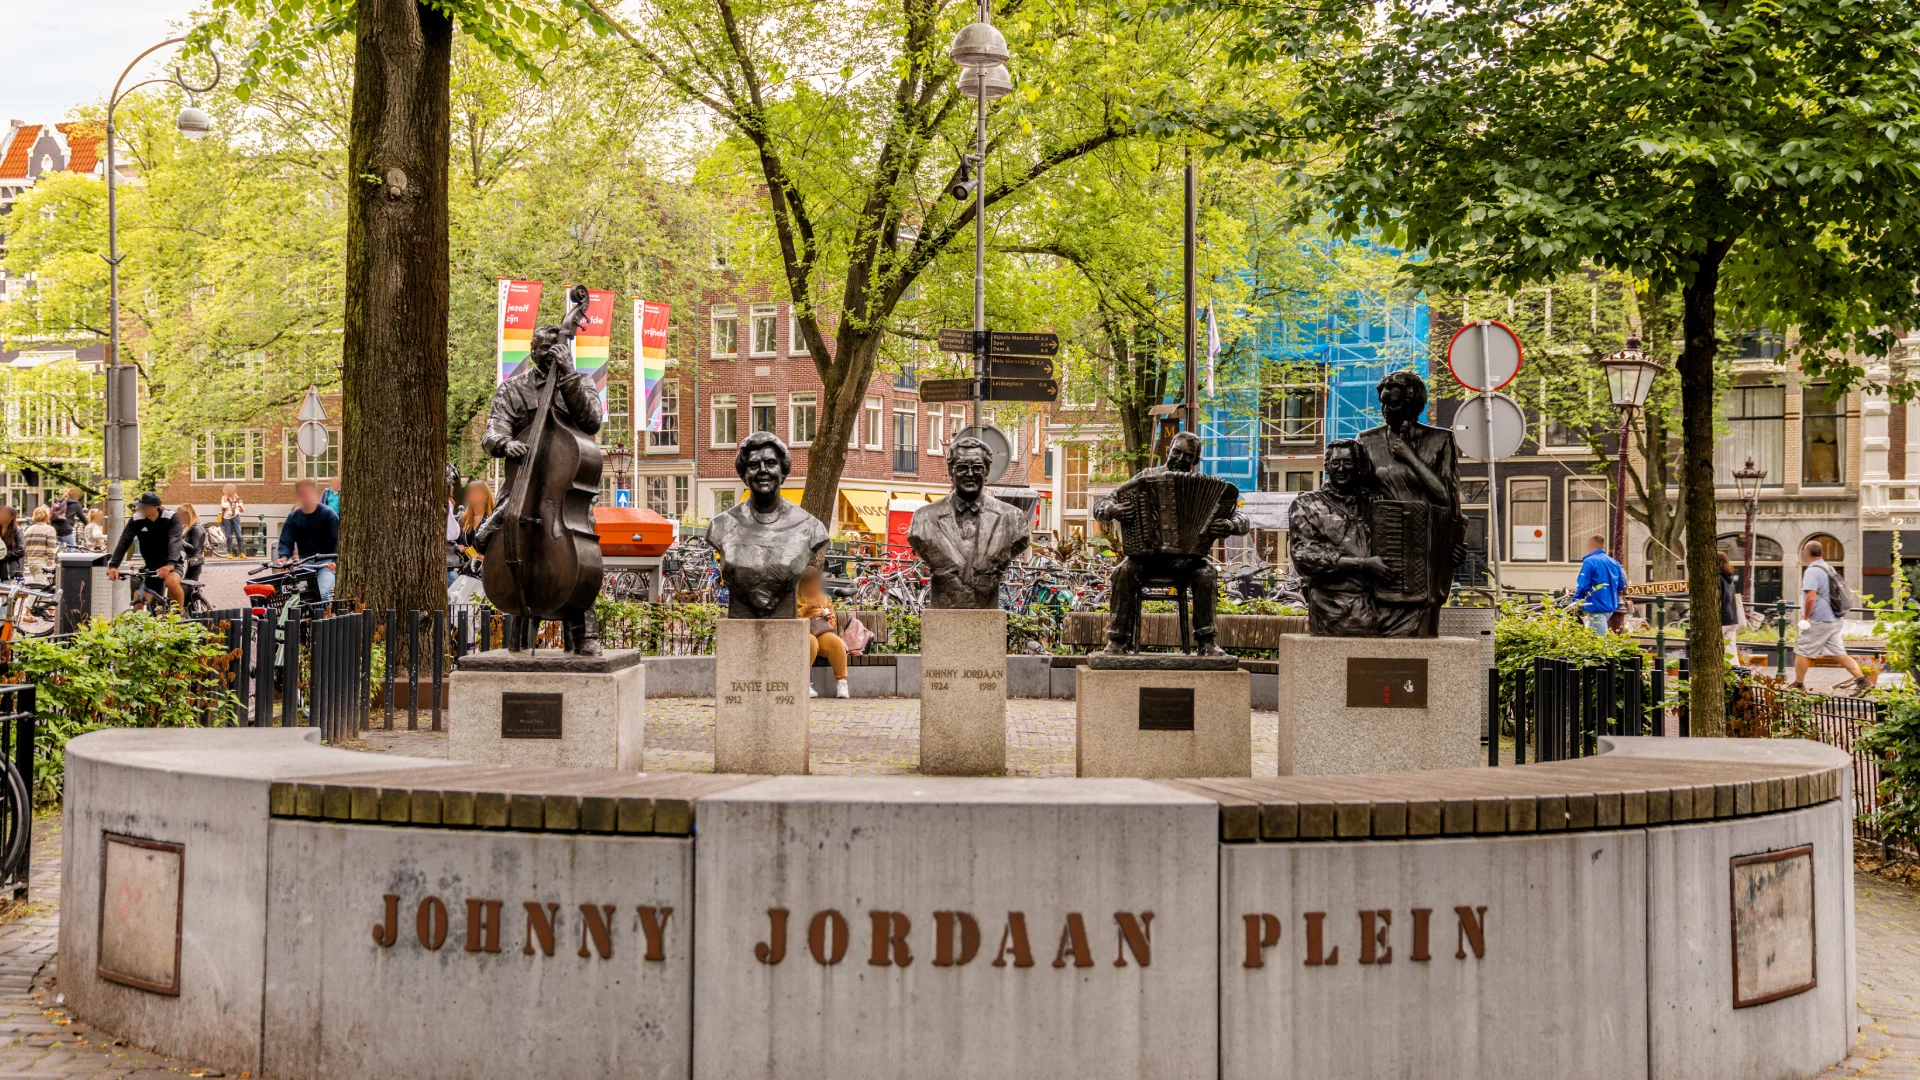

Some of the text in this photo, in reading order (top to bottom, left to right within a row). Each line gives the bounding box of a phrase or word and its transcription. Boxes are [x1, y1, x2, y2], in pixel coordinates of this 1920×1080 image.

[507, 303, 530, 313] jezelf
[506, 314, 519, 324] zijn
[643, 327, 666, 338] vrijheid
[924, 669, 1004, 679] JOHNNY JORDAAN
[731, 681, 789, 692] TANTE LEEN
[930, 682, 997, 691] 1924 1989
[725, 695, 795, 704] 1912 1992
[372, 894, 1488, 968] JOHNNY JORDAAN PLEIN
